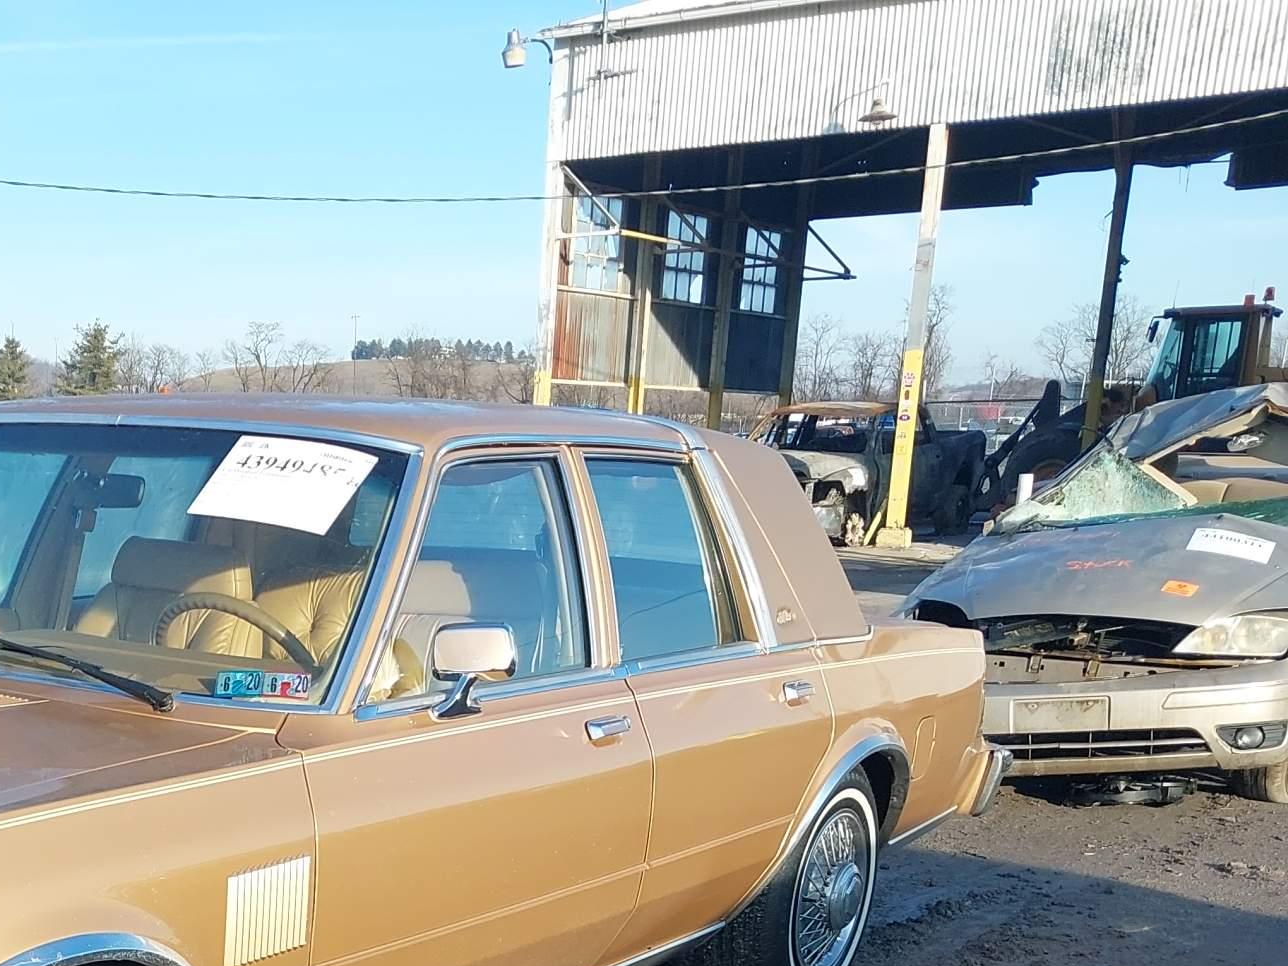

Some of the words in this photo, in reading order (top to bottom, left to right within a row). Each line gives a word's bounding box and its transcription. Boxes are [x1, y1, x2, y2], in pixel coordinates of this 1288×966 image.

[223, 676, 231, 692] 6
[247, 673, 261, 691] 20
[271, 677, 278, 693] 6
[295, 675, 309, 694] 20
